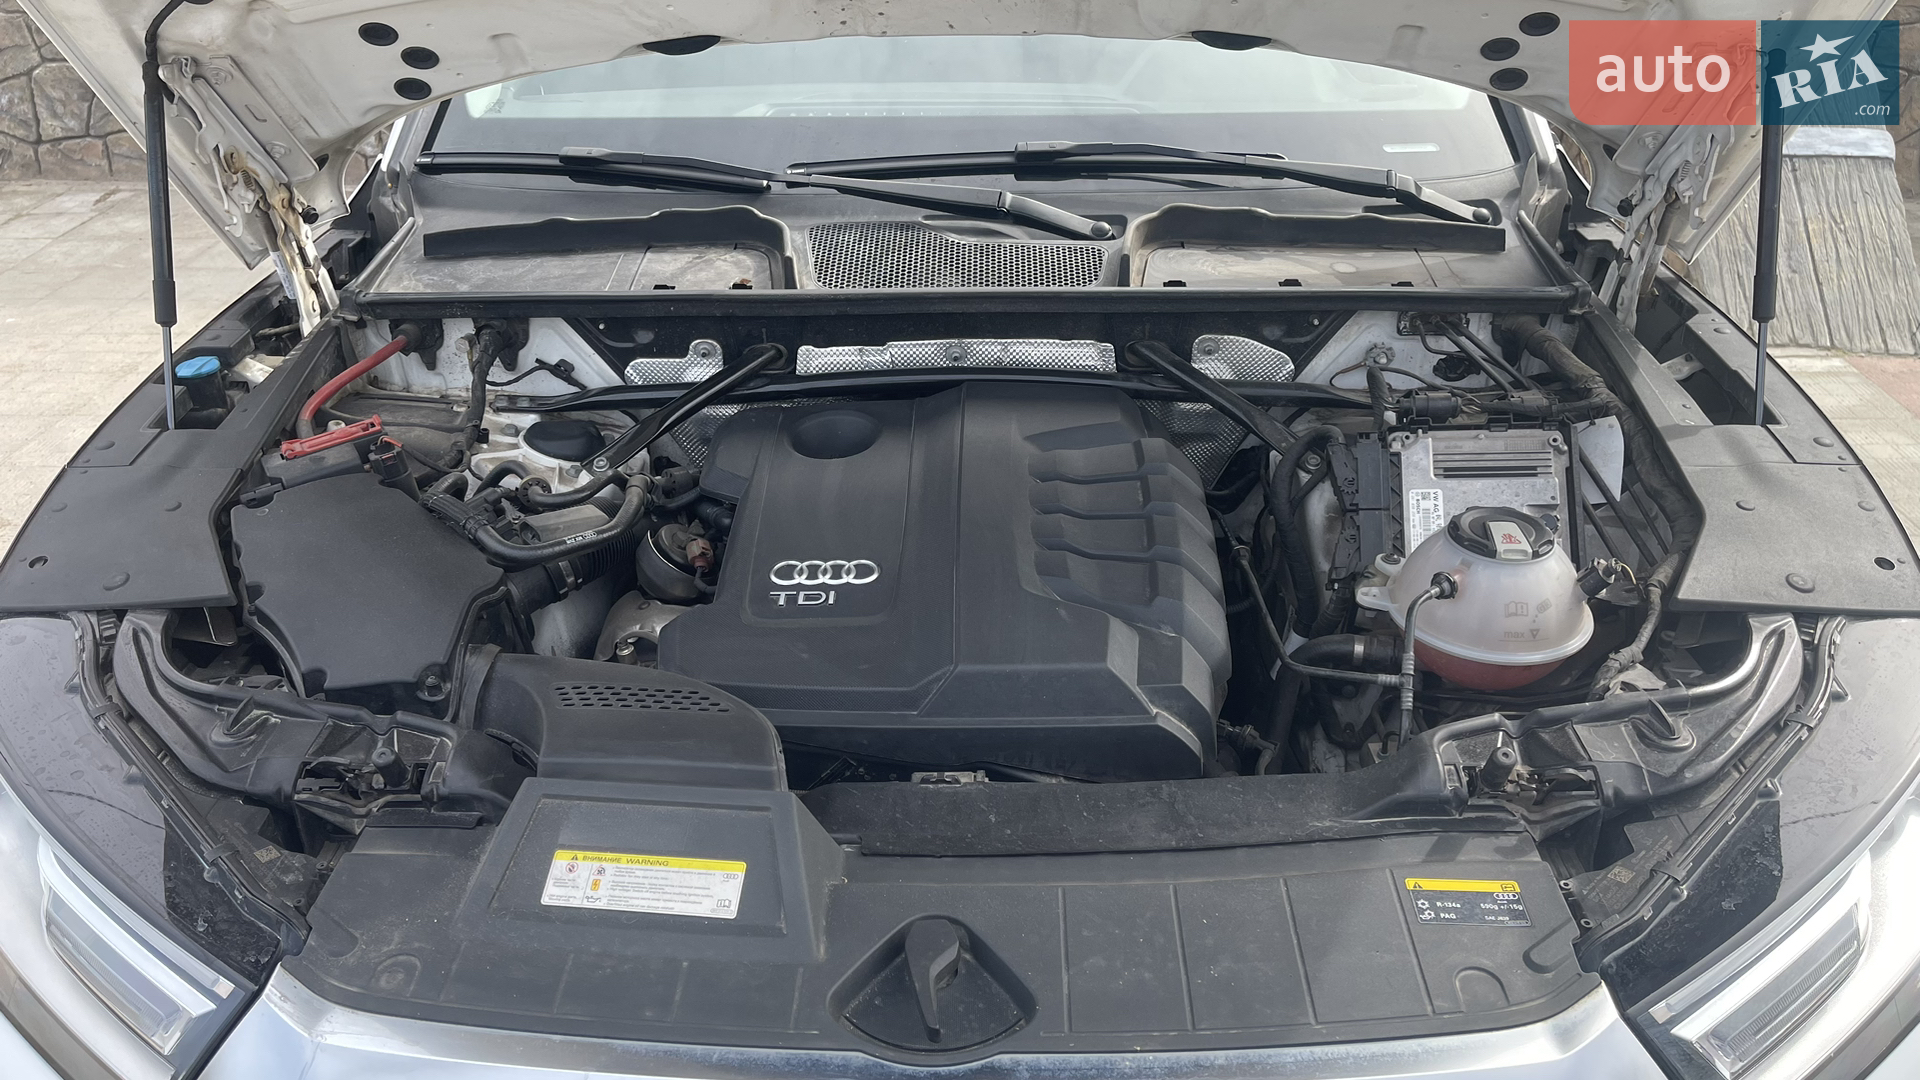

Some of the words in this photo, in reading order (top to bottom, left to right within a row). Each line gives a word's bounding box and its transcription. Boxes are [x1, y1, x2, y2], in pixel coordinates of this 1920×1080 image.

[1433, 491, 1439, 502] VW
[1433, 503, 1440, 513] AG
[769, 591, 836, 606] TDI
[1503, 631, 1526, 639] max
[582, 855, 622, 864] ВНИМАНИЕ
[626, 858, 669, 867] WARNING
